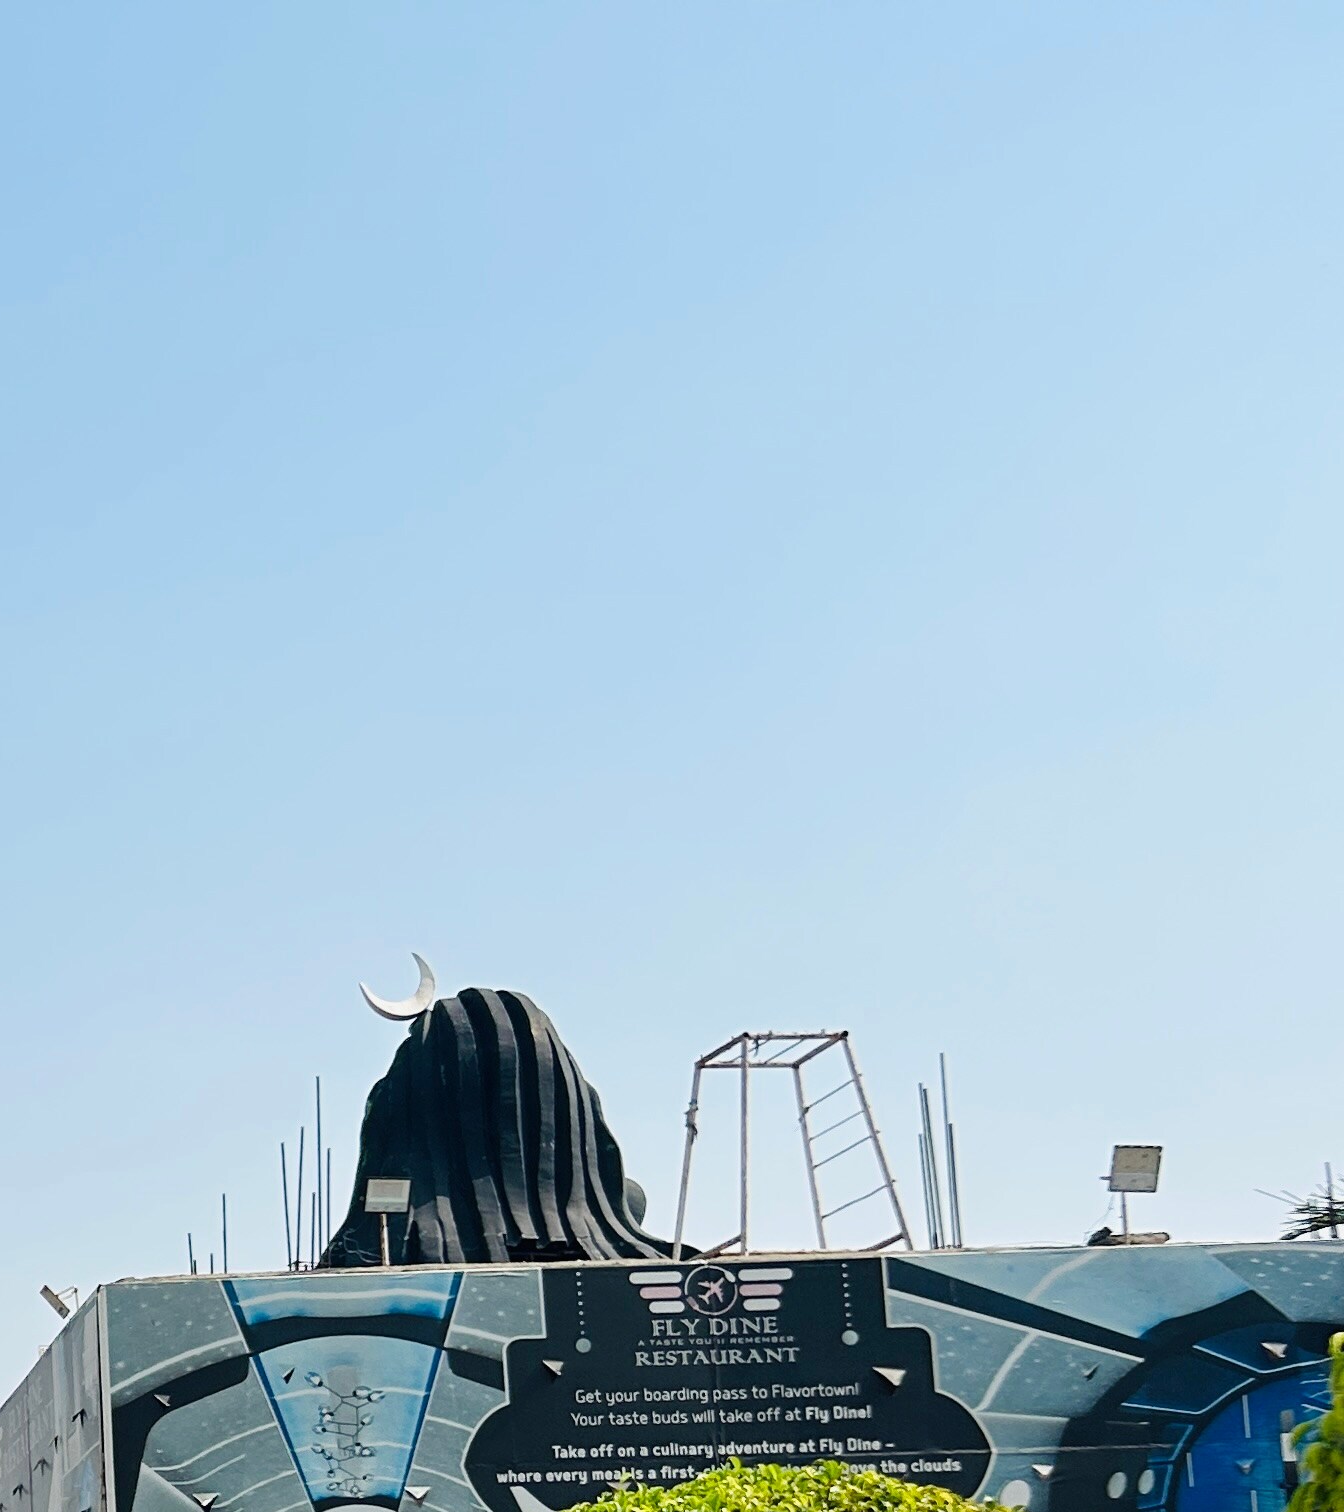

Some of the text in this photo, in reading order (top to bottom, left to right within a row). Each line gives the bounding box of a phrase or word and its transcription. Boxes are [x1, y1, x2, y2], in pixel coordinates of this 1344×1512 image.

[651, 1316, 779, 1337] FLY DINE
[650, 1338, 684, 1346] TASTE
[730, 1336, 795, 1344] REMEMBER
[635, 1347, 800, 1366] RESTAURANT
[575, 1382, 860, 1406] Get your boarding pass to Flavortown!
[570, 1404, 873, 1427] Your taste buds will take off at Fly Dine!
[552, 1444, 587, 1459] Take
[590, 1443, 614, 1458] off
[617, 1446, 636, 1458] on
[639, 1446, 649, 1457] a
[652, 1442, 713, 1459] culinary
[717, 1441, 795, 1456] adventure
[798, 1439, 816, 1453] at
[819, 1438, 843, 1456] Fly
[847, 1437, 882, 1452] Dine
[496, 1469, 542, 1483] where
[545, 1471, 588, 1485] every
[647, 1468, 657, 1480] a
[880, 1459, 908, 1474] the
[910, 1458, 963, 1473] clouds
